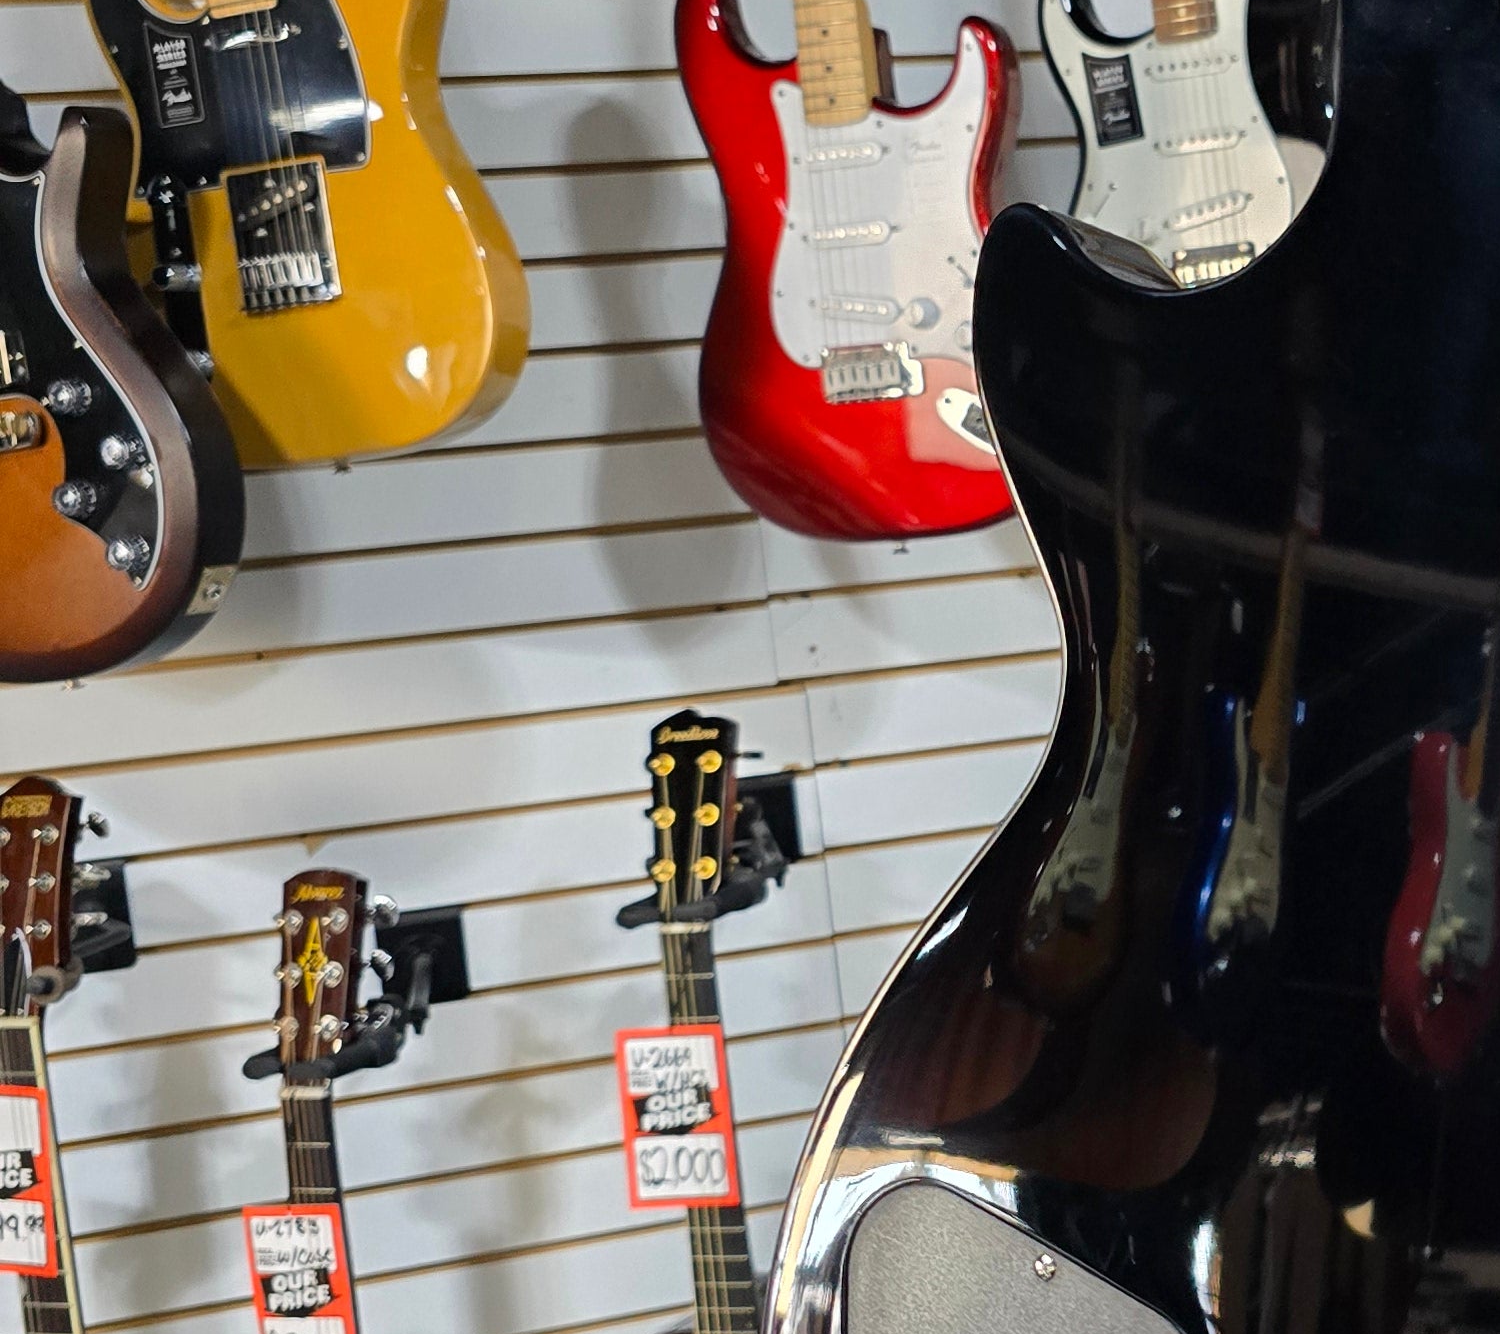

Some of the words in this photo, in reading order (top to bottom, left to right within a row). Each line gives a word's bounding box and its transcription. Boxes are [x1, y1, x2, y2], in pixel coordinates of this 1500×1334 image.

[646, 1088, 699, 1112] OUR
[640, 1101, 713, 1133] PRICE
[271, 1269, 319, 1293] OUR
[268, 1283, 332, 1313] PRICE
